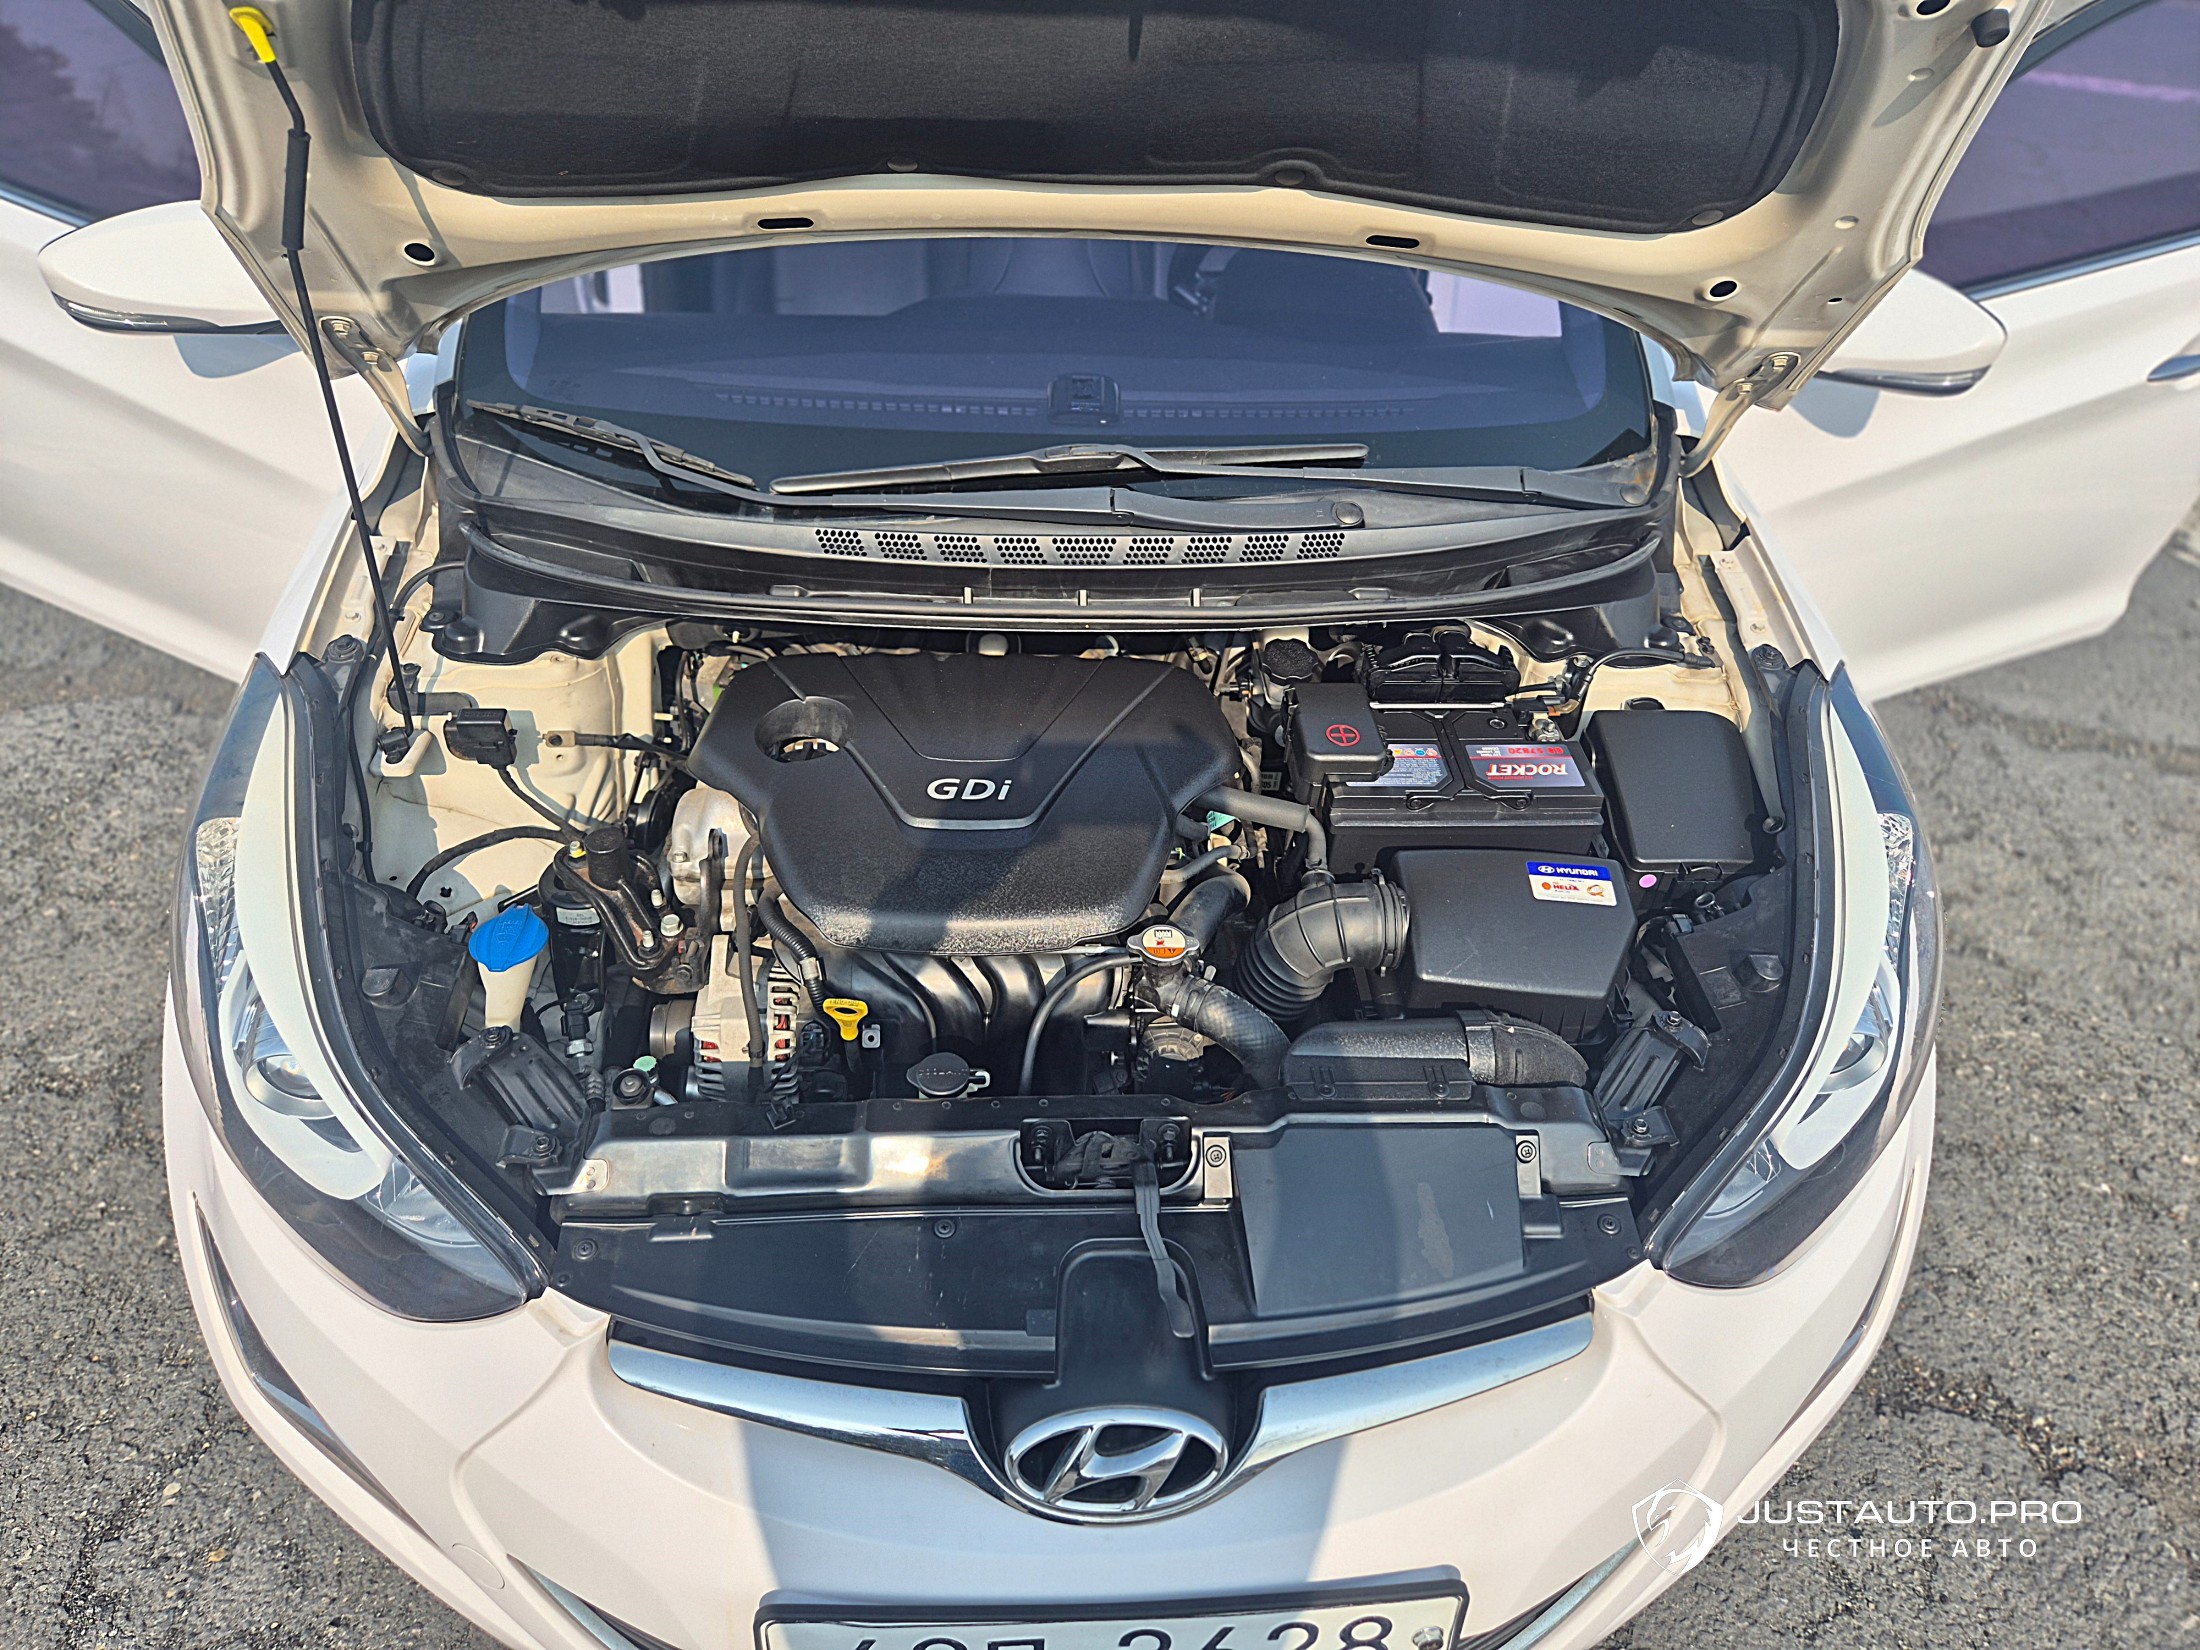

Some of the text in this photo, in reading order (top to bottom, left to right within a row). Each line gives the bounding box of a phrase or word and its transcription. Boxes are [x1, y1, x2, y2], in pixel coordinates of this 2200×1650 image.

[1486, 763, 1568, 776] ROCKET
[926, 778, 1012, 800] GDi
[1556, 867, 1598, 877] HYUNDAI
